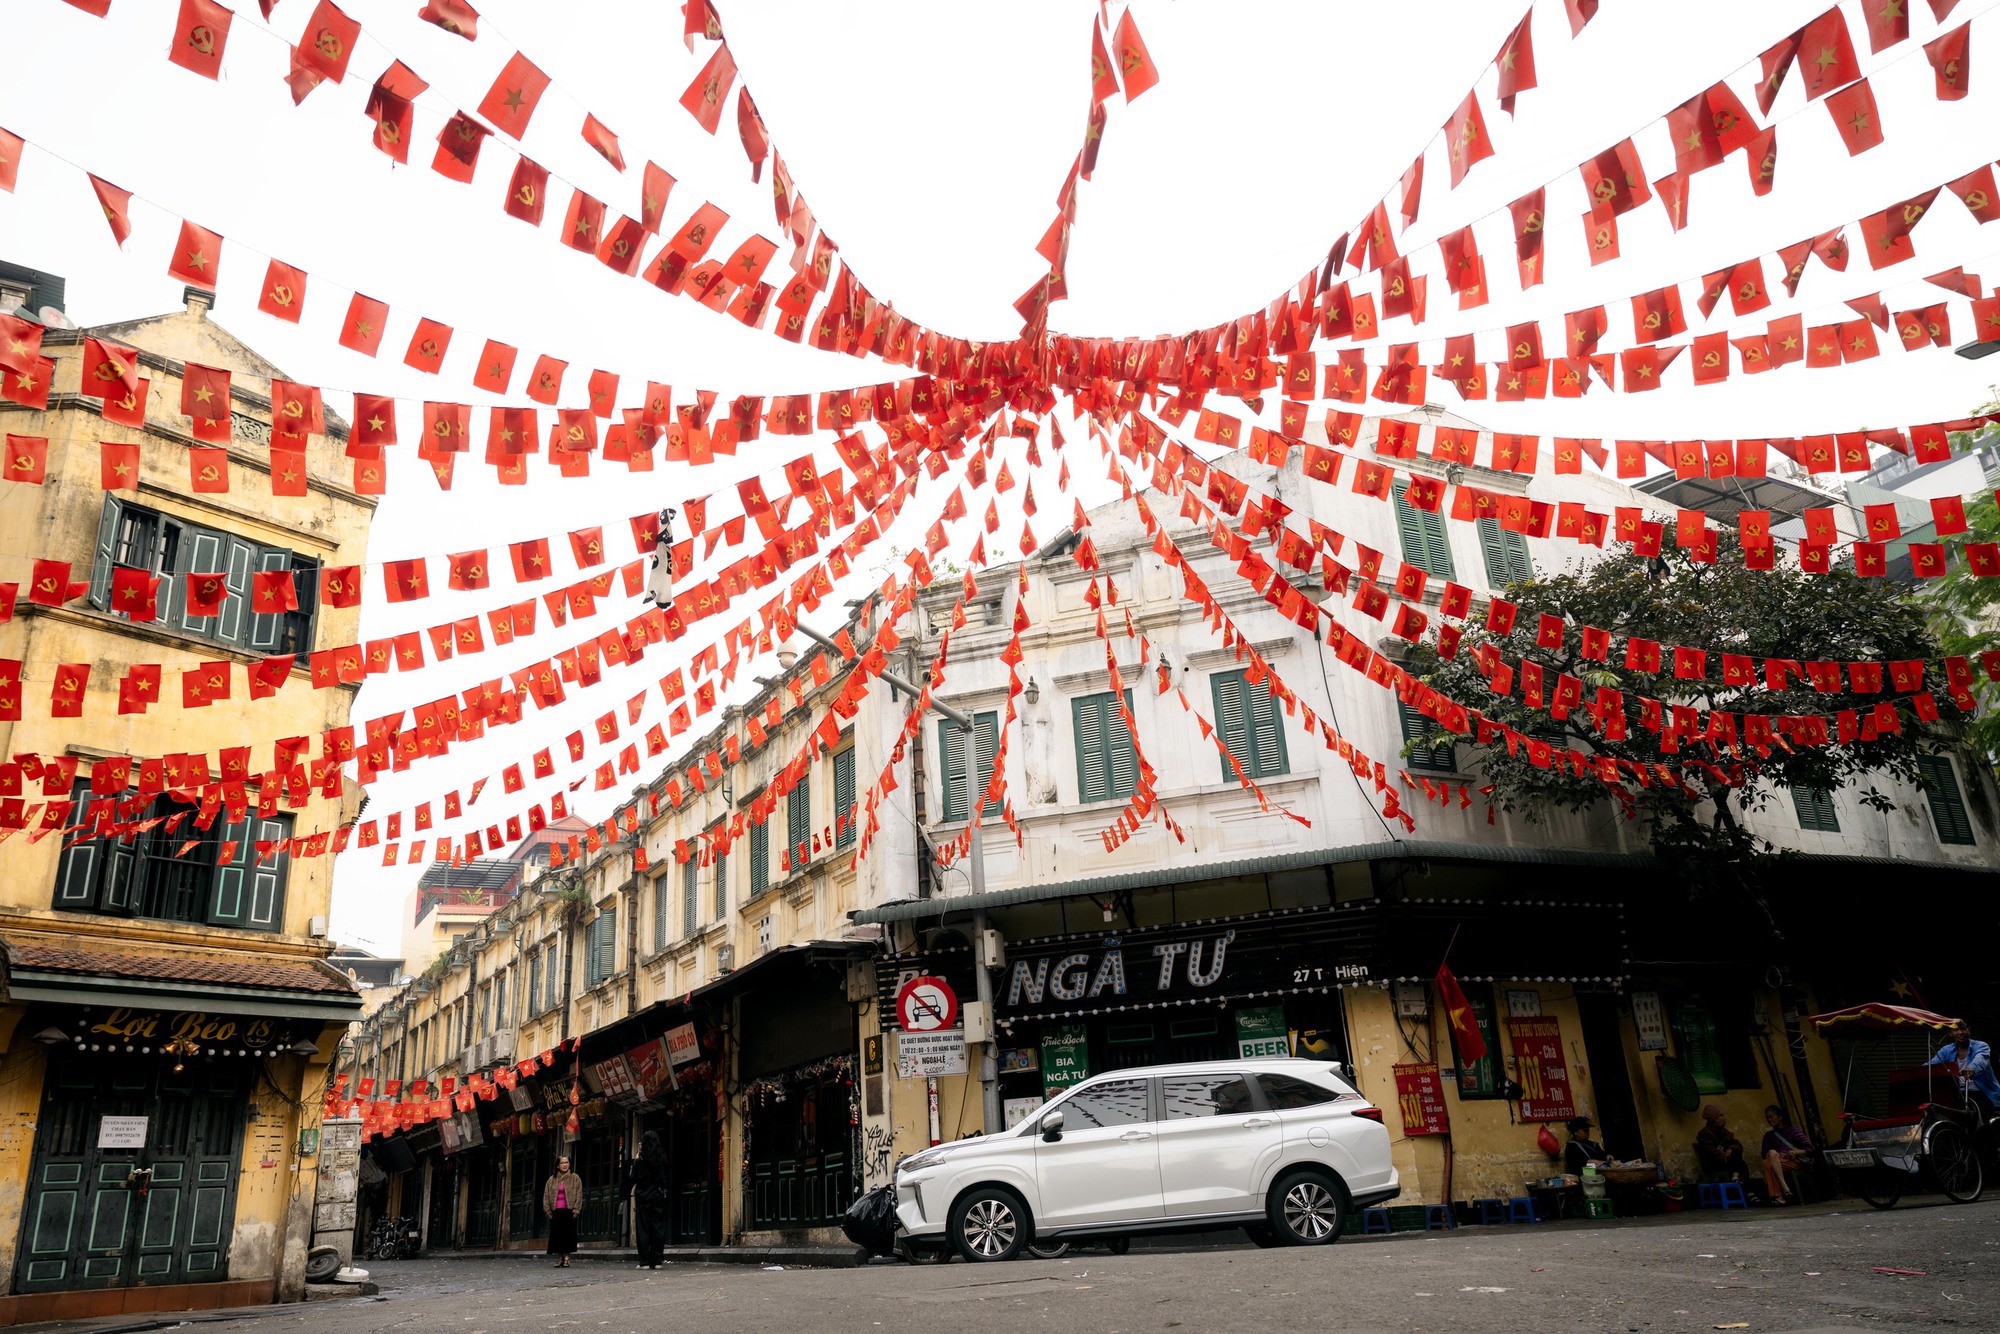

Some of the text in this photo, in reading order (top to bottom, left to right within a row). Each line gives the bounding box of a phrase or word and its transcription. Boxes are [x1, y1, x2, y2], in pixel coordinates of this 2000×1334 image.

[1007, 936, 1127, 1006] NGÃ
[1152, 929, 1235, 991] TƯ
[1293, 970, 1310, 983] 27
[1335, 964, 1369, 979] Hiện
[90, 1007, 238, 1043] Lợi Béo
[1242, 1041, 1288, 1058] BEER
[1055, 1057, 1075, 1067] BIA
[1046, 1069, 1086, 1082] NGÃ TƯ
